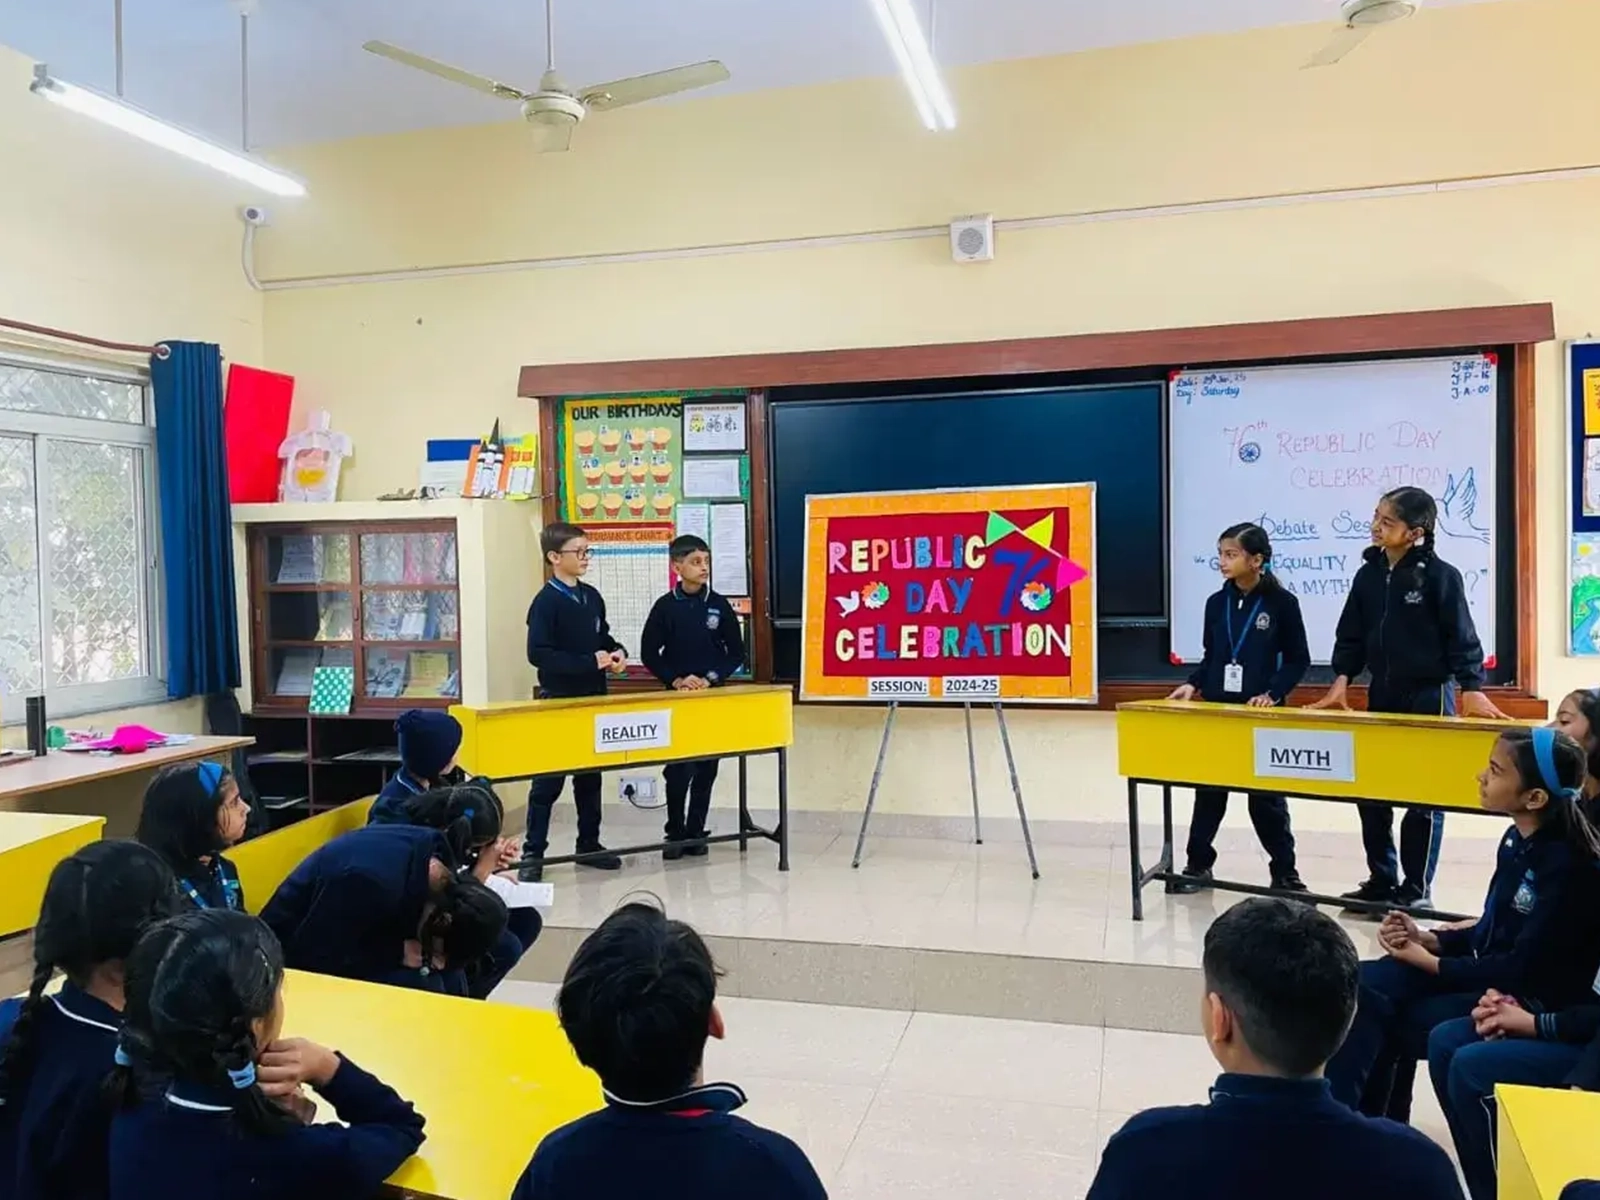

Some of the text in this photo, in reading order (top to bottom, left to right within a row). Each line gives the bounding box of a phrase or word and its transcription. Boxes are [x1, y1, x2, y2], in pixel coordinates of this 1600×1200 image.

[1201, 386, 1240, 399] Saturday
[572, 403, 682, 420] OUR BIRTHDAYS
[1290, 465, 1448, 489] CELEBRATION
[1255, 512, 1318, 535] Debate
[828, 535, 986, 574] REPUBLIC
[1272, 554, 1348, 573] EQUALITY
[906, 547, 1054, 616] DAY 76
[1287, 578, 1350, 596] A MYTH
[835, 622, 1072, 662] CELEBRATION
[871, 678, 998, 692] SESSION: 2024-25
[602, 724, 658, 740] REALITY
[1270, 747, 1331, 767] MYTH
